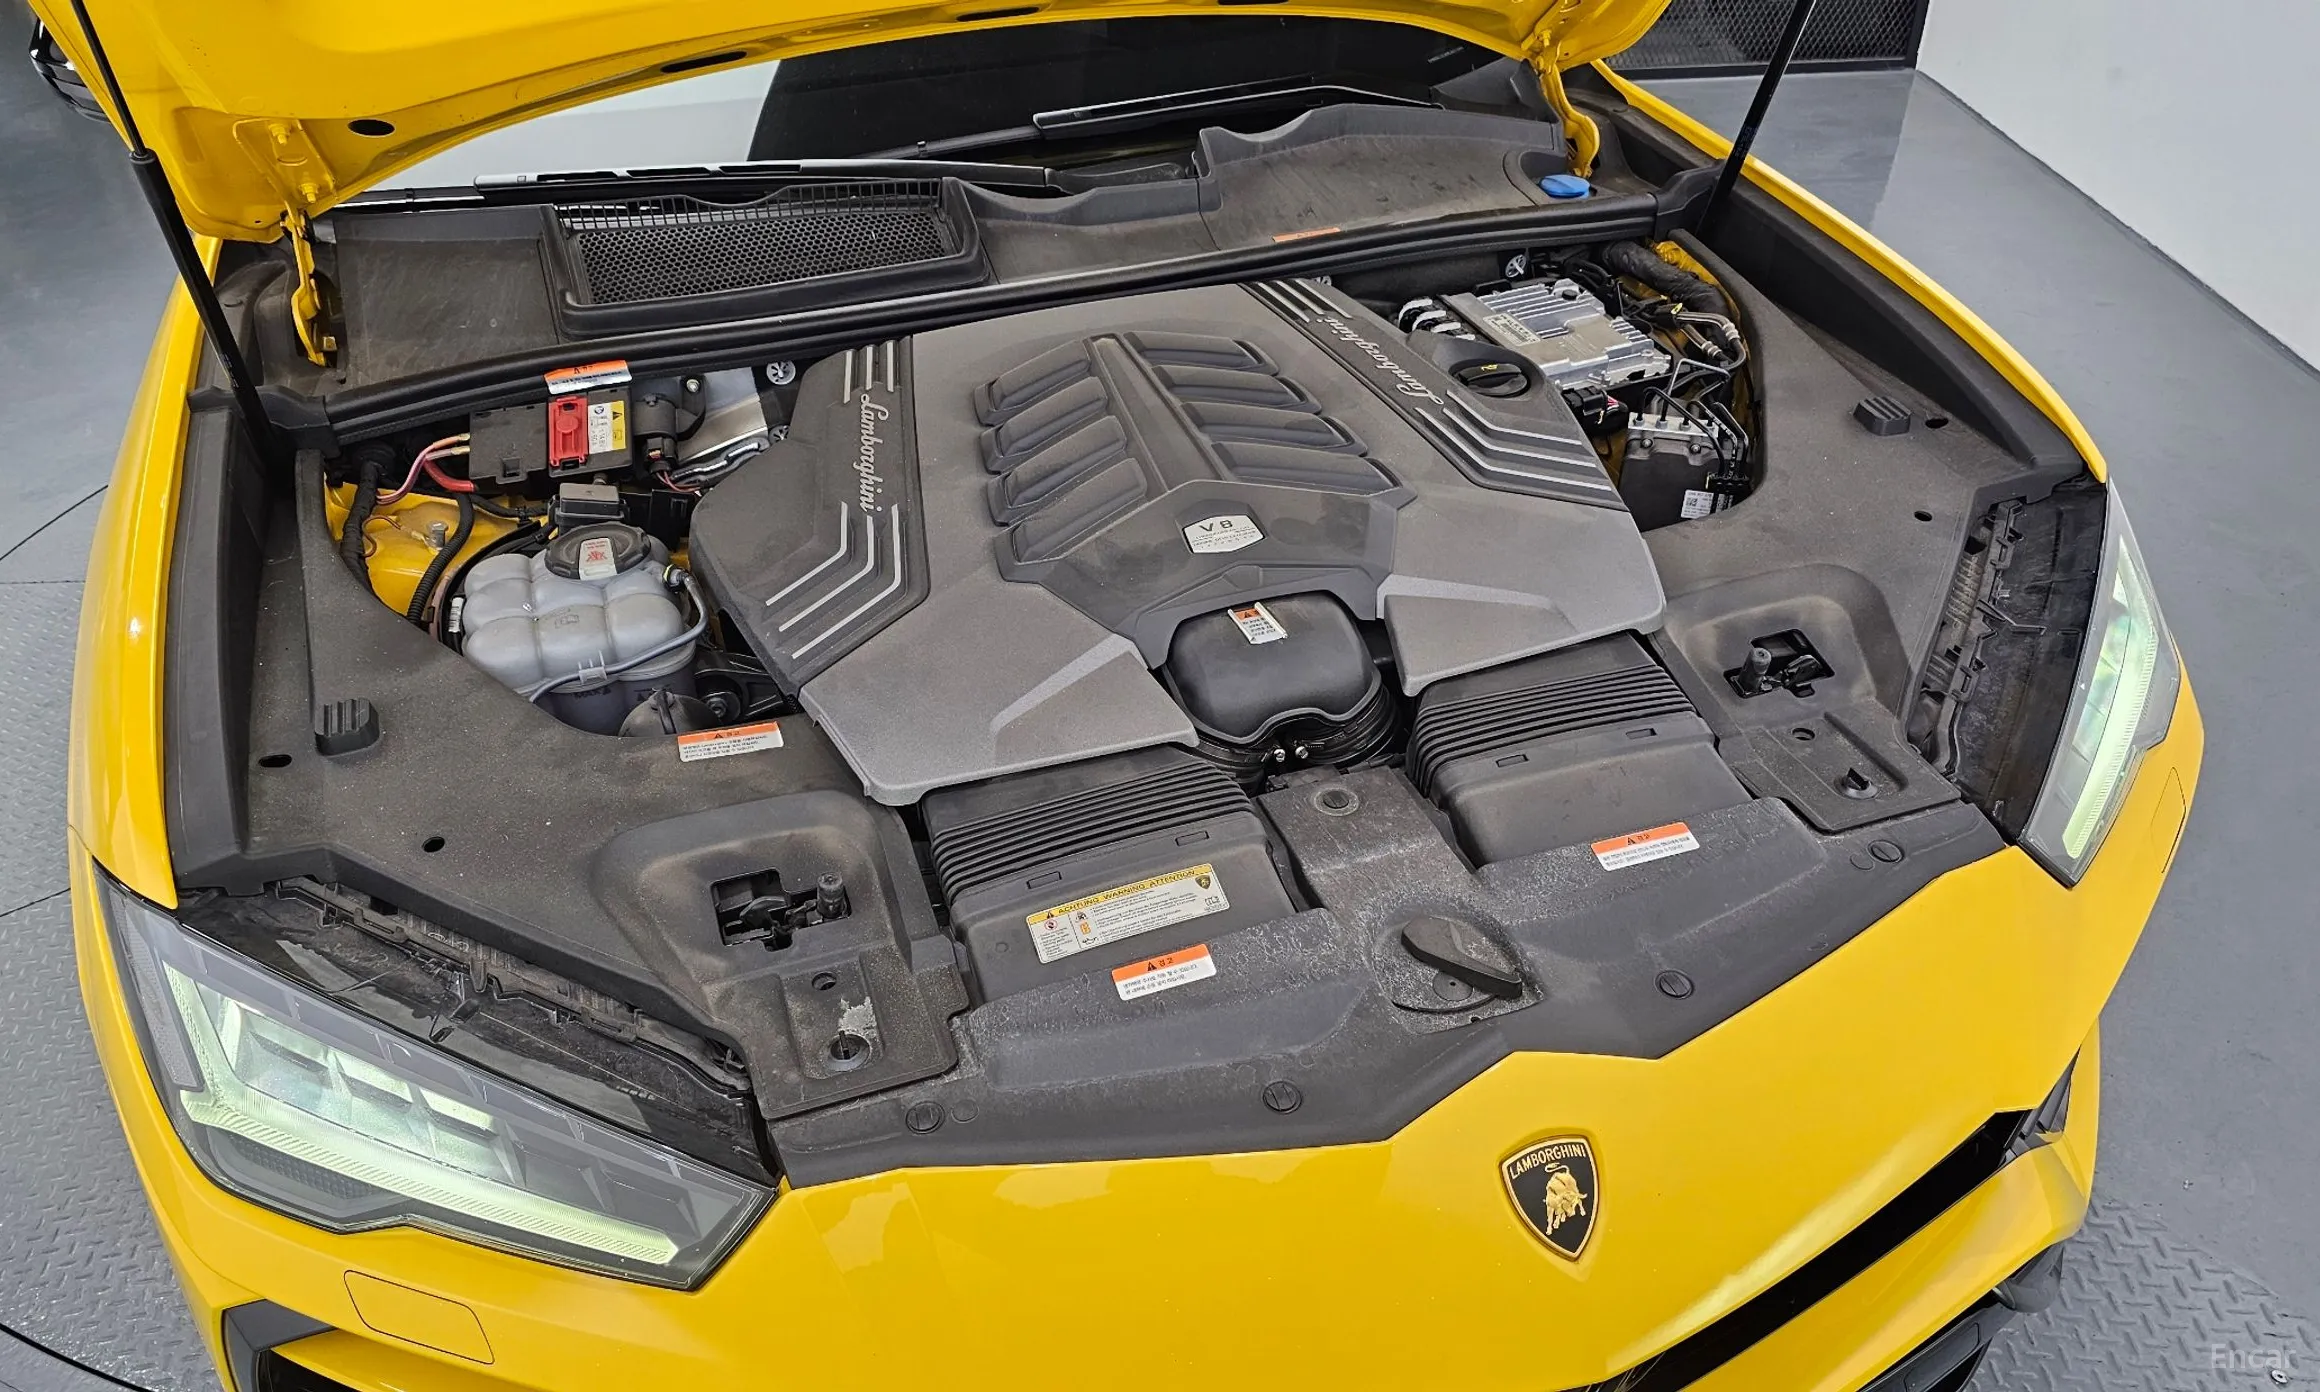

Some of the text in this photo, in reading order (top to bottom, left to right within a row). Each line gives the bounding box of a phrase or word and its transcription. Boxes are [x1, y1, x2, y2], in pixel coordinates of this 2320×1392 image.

[1316, 316, 1444, 405] Lamborghini
[853, 394, 888, 511] Lamborghini
[1058, 897, 1100, 914] ACHTUNG
[1102, 883, 1146, 900] WARNING
[1149, 870, 1195, 887] ATTENTION
[1509, 1144, 1586, 1180] LAMBORGHINI
